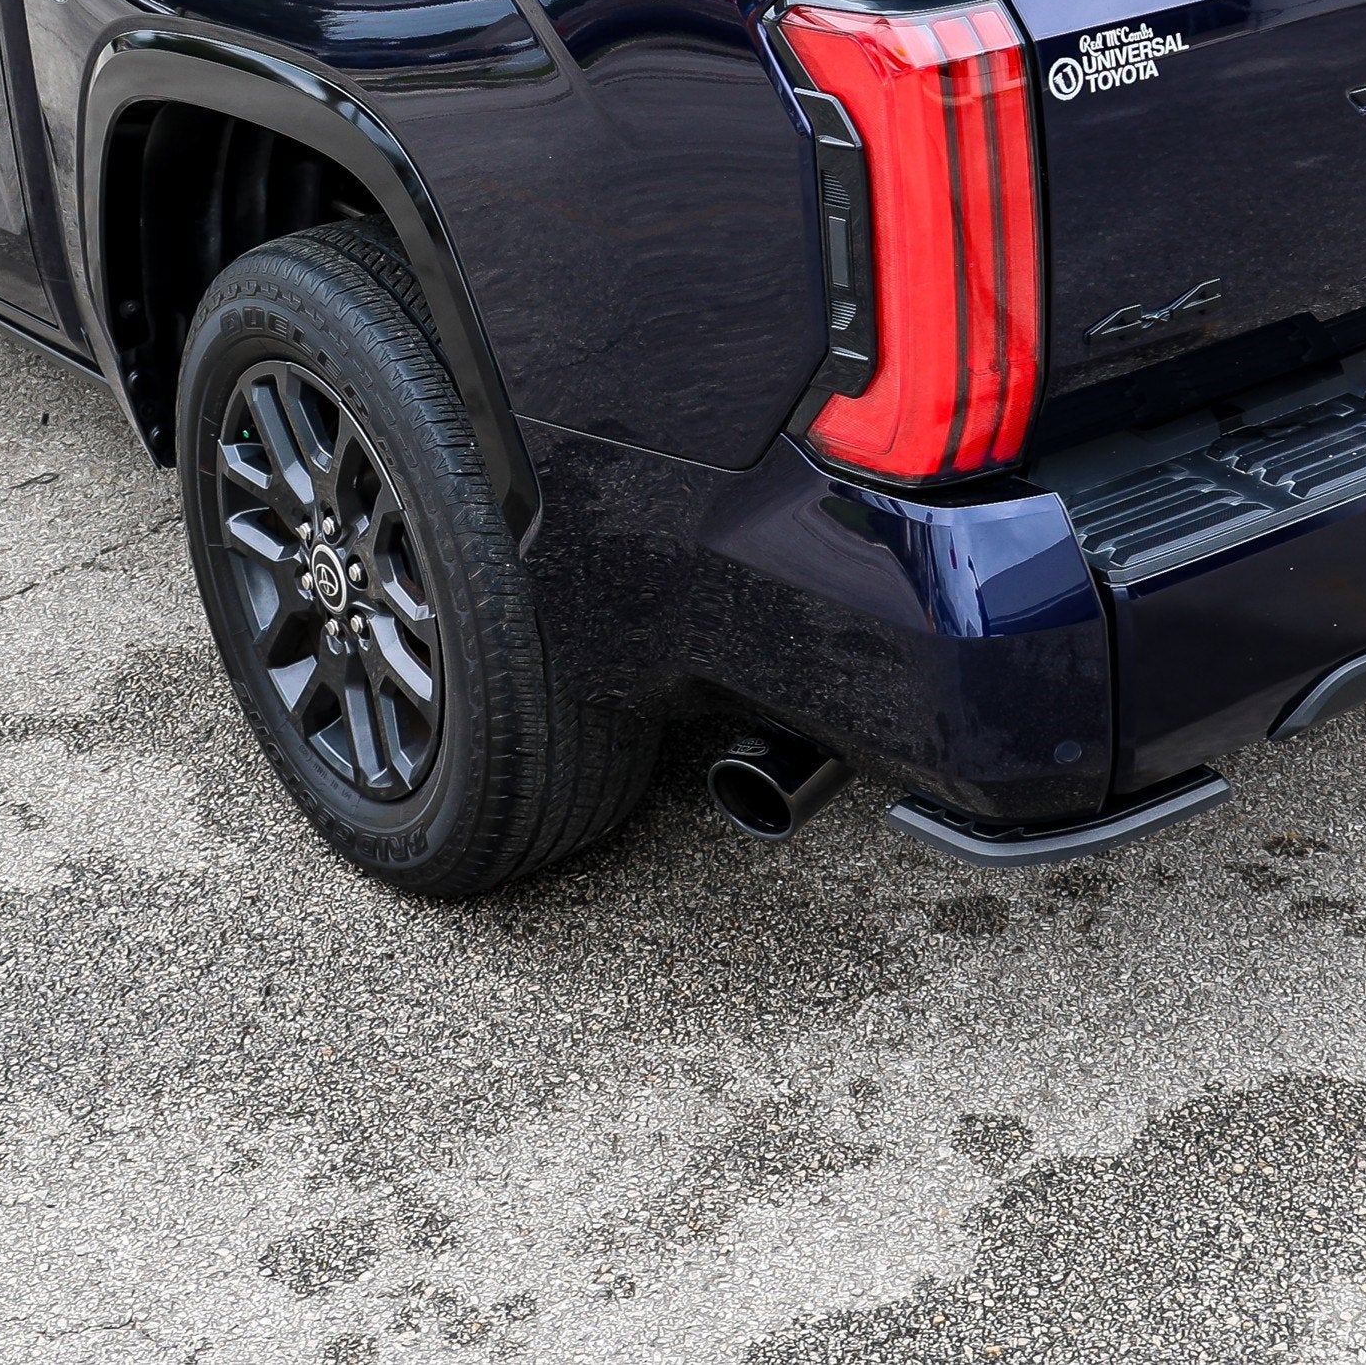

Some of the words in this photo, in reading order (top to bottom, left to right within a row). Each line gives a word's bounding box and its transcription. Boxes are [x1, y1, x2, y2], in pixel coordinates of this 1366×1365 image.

[1079, 34, 1104, 56] Red
[1082, 32, 1190, 74] UNIVERSAL
[1085, 60, 1160, 93] TOYOTA
[219, 305, 371, 425] DUELER
